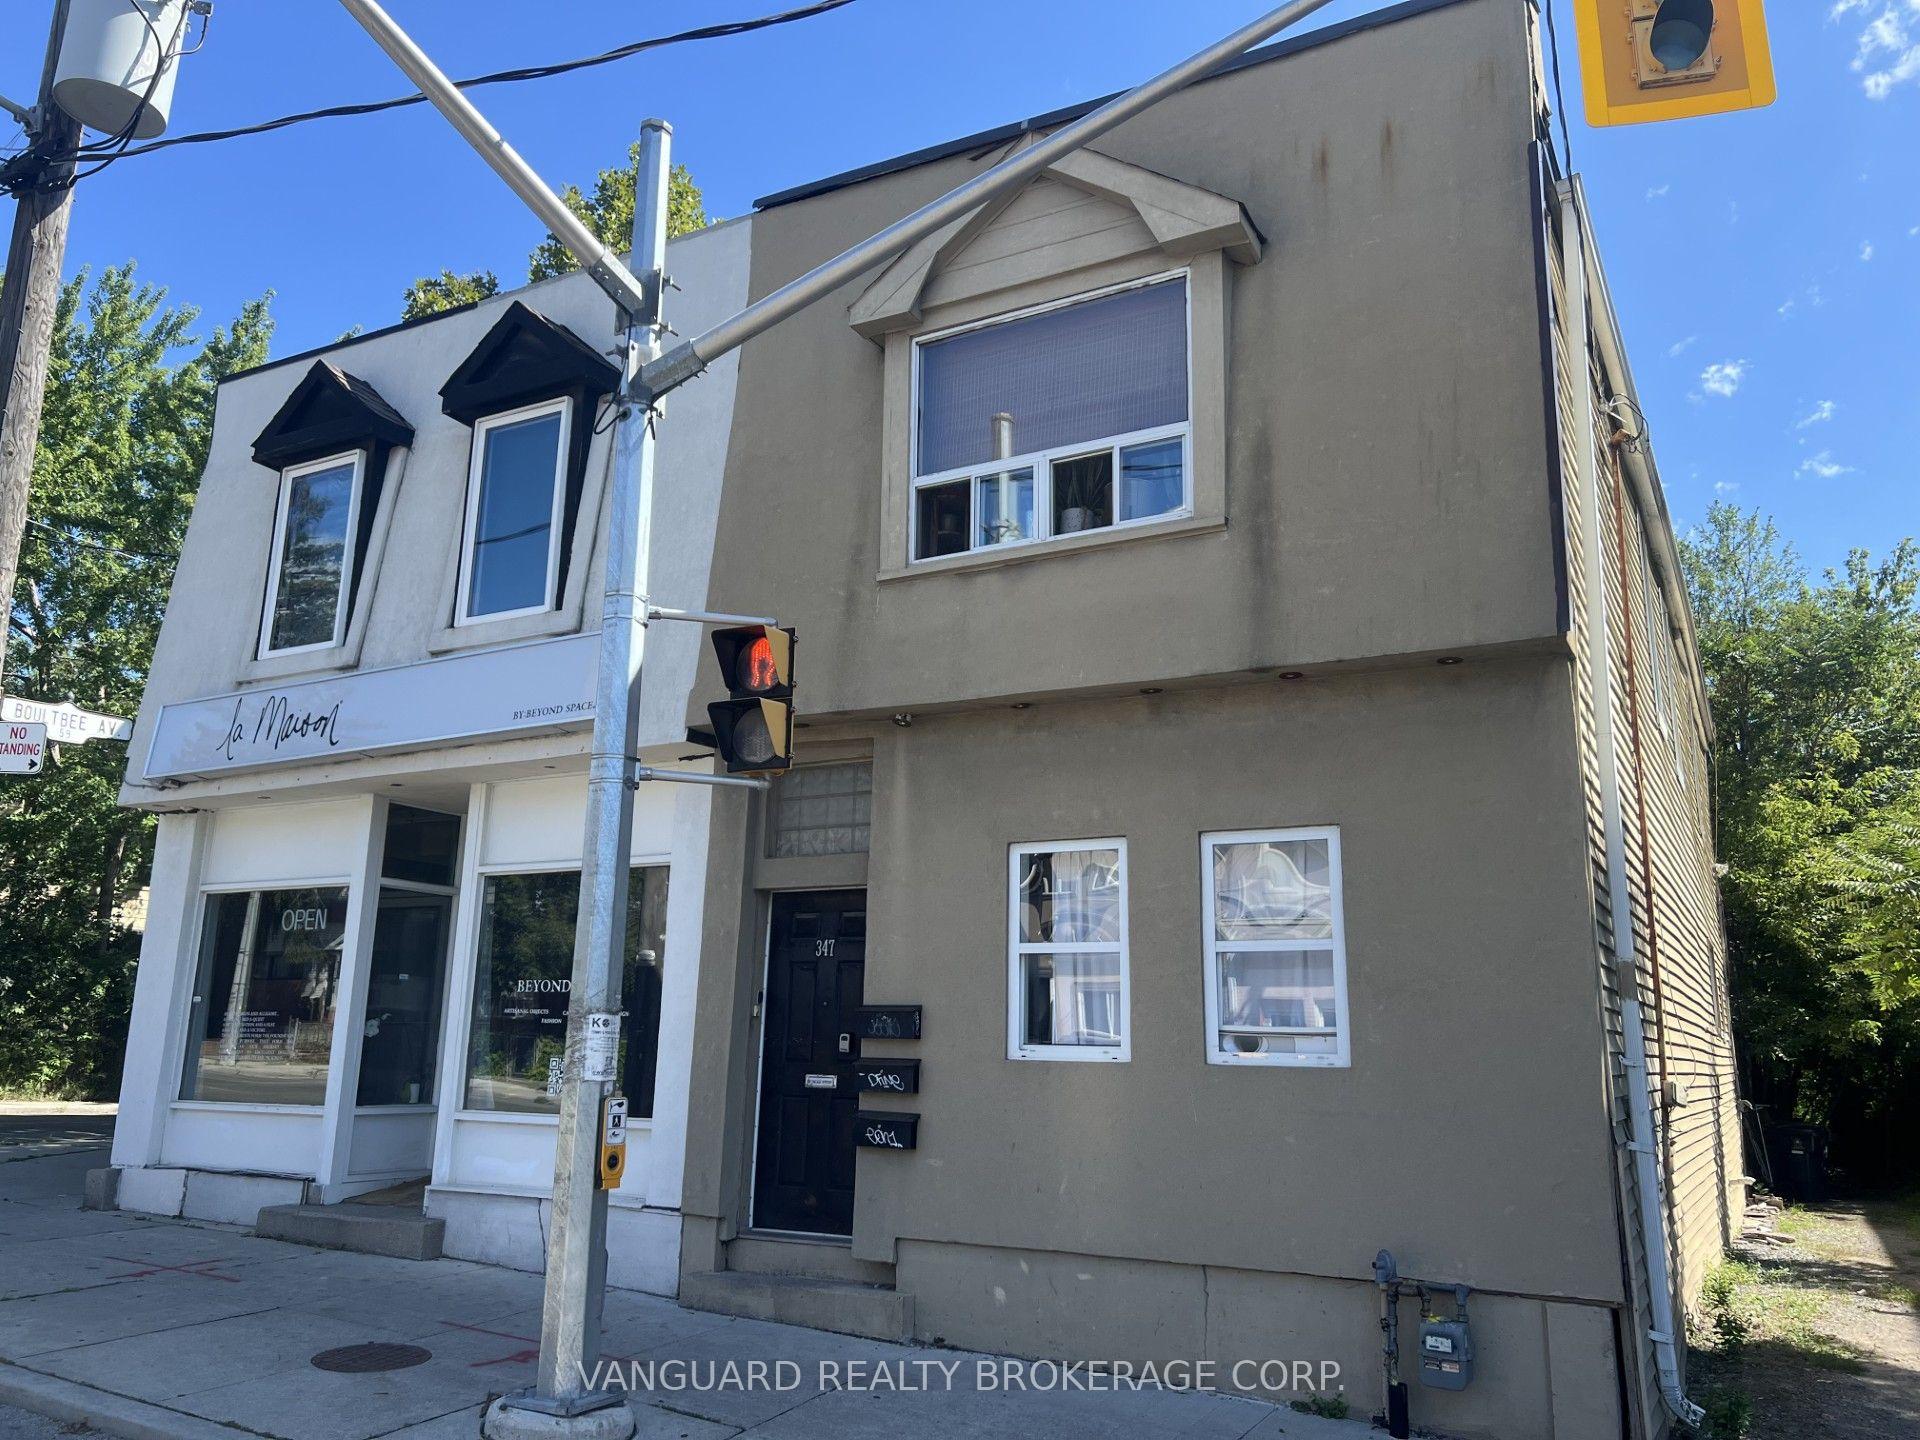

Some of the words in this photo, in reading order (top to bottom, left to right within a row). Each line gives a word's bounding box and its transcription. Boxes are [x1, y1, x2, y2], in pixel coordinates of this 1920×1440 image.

[513, 711, 524, 720] BY
[526, 705, 563, 719] BEYOND
[10, 727, 27, 740] NO
[0, 743, 40, 756] TANDING
[282, 908, 327, 931] OPEN
[815, 939, 835, 957] 347
[517, 979, 571, 993] BEYOND
